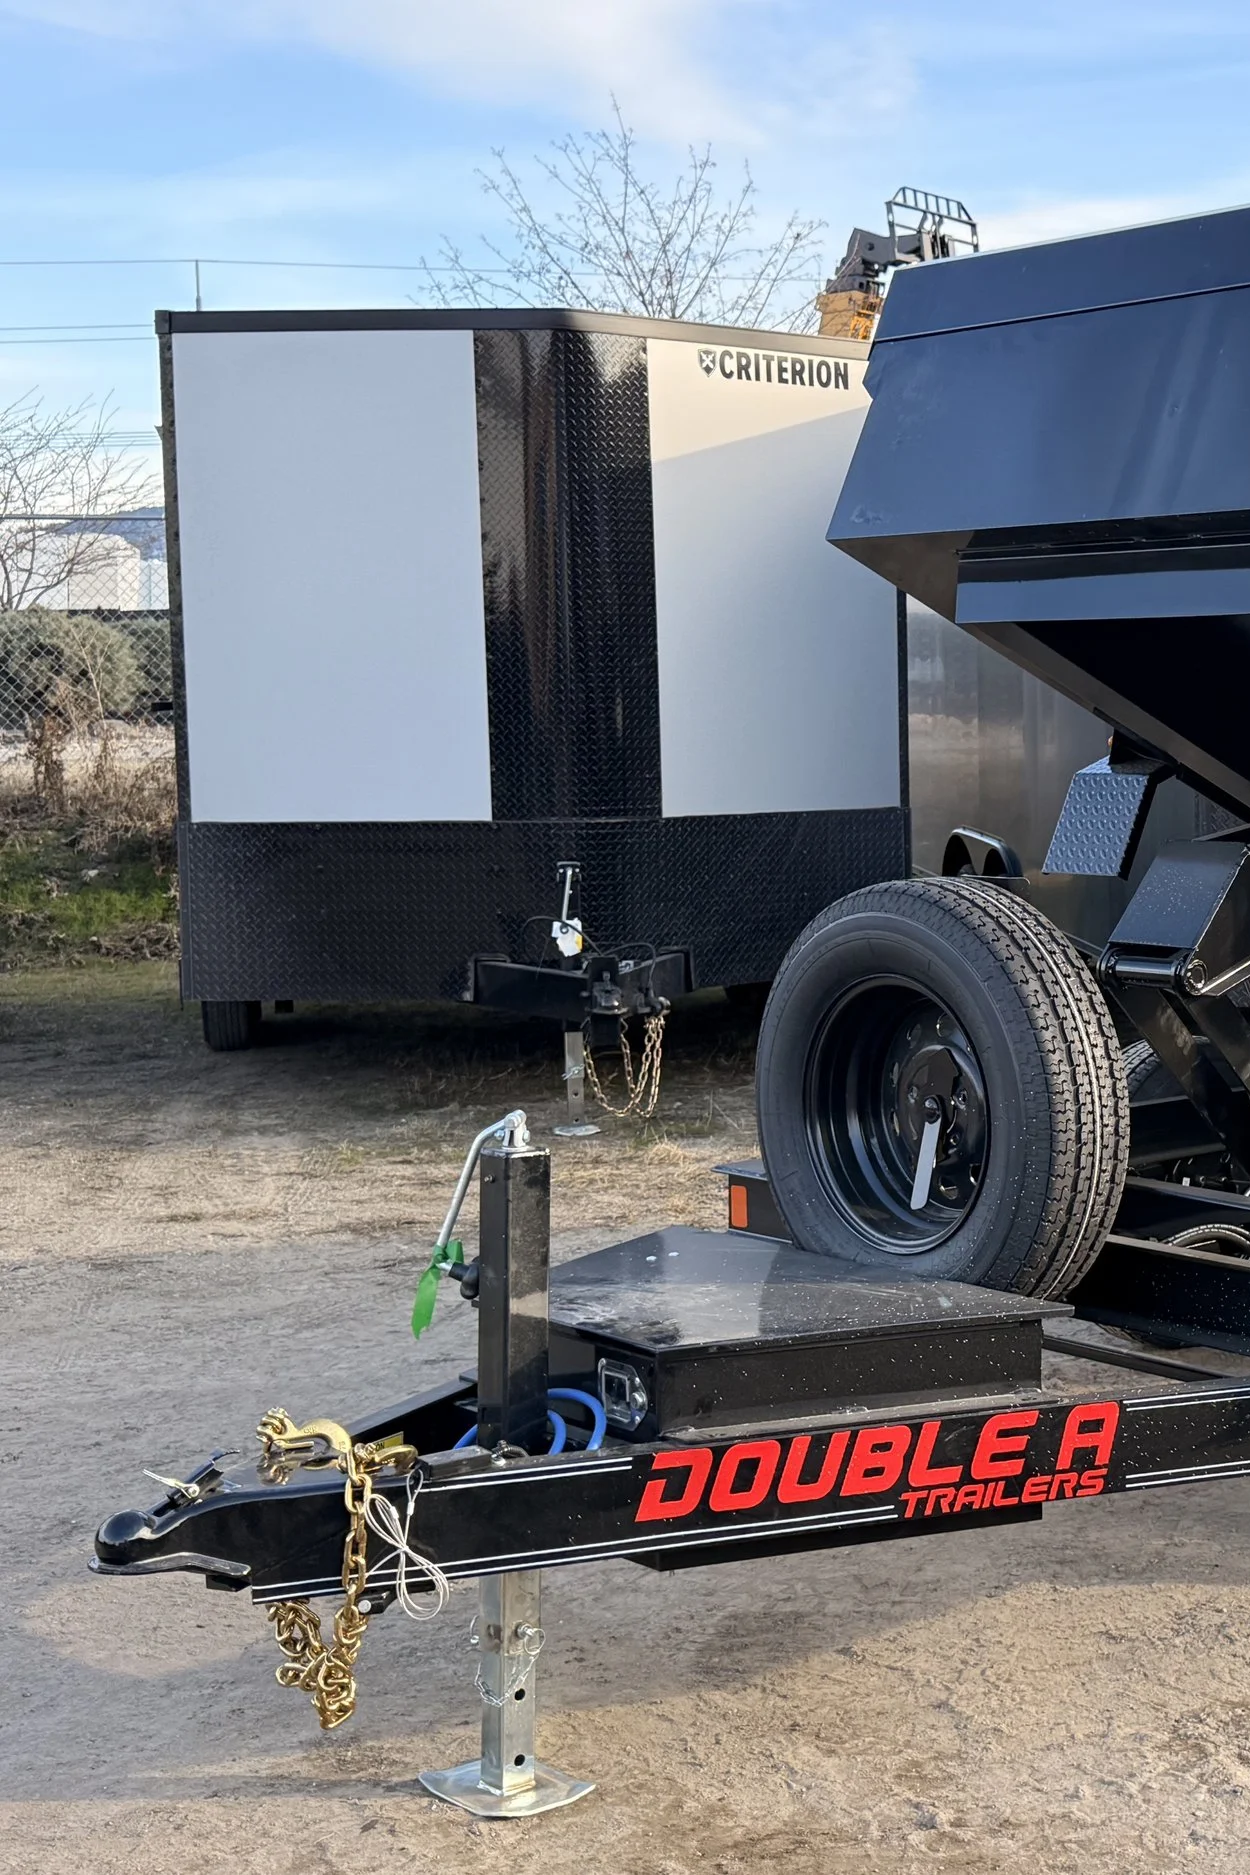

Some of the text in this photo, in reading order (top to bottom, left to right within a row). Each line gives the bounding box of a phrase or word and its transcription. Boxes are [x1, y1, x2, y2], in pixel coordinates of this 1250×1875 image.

[719, 350, 849, 390] CRITERION
[635, 1401, 1120, 1523] DOUBLE A
[898, 1468, 1108, 1518] TRAILERS
